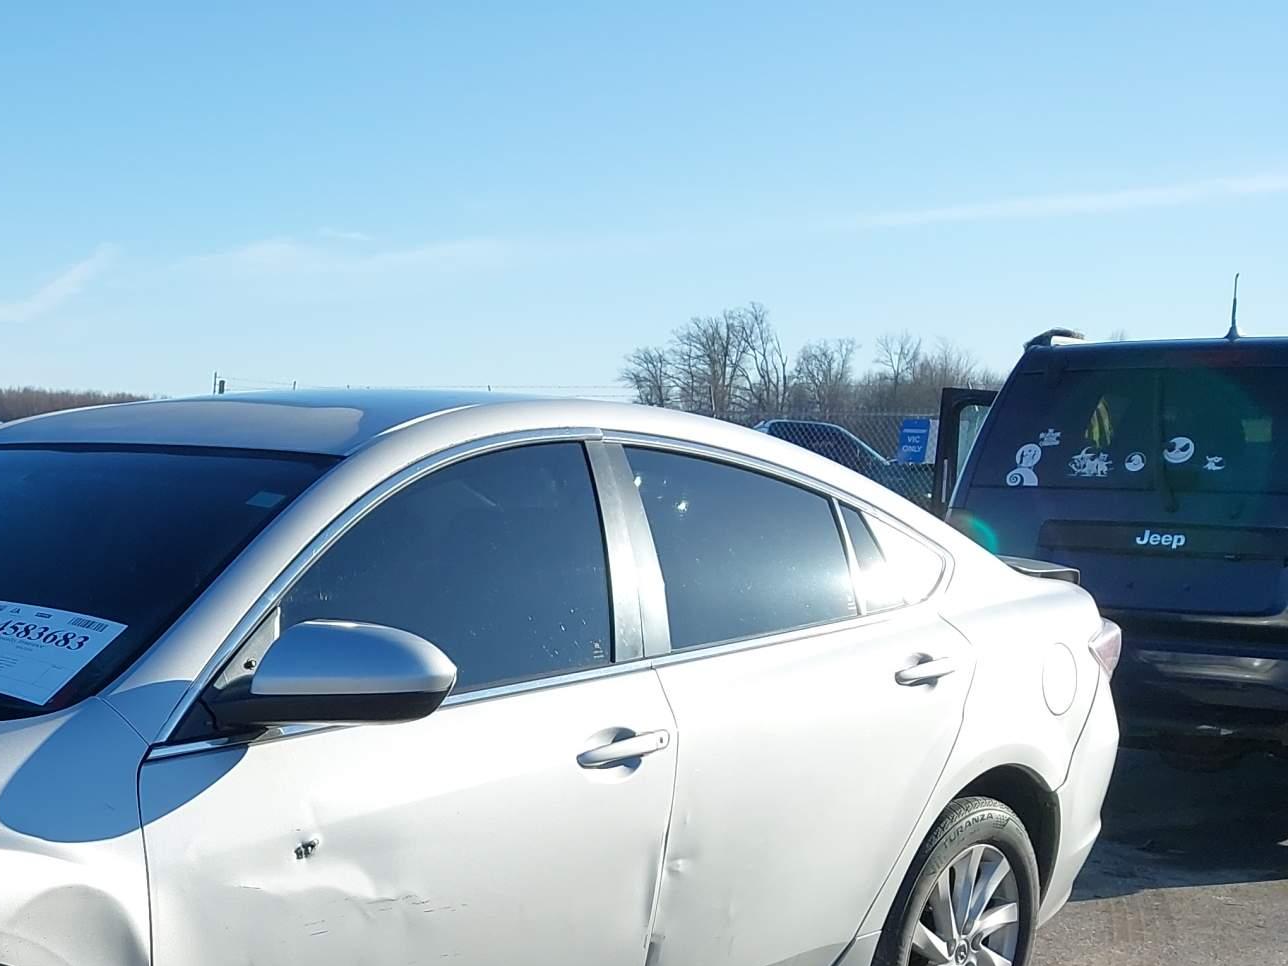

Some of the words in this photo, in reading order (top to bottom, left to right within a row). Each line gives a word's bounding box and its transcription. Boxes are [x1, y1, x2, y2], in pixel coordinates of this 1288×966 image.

[907, 435, 921, 443] VIC
[902, 445, 922, 453] ONLY
[1135, 529, 1186, 549] Jeep
[943, 812, 994, 849] TURANZA
